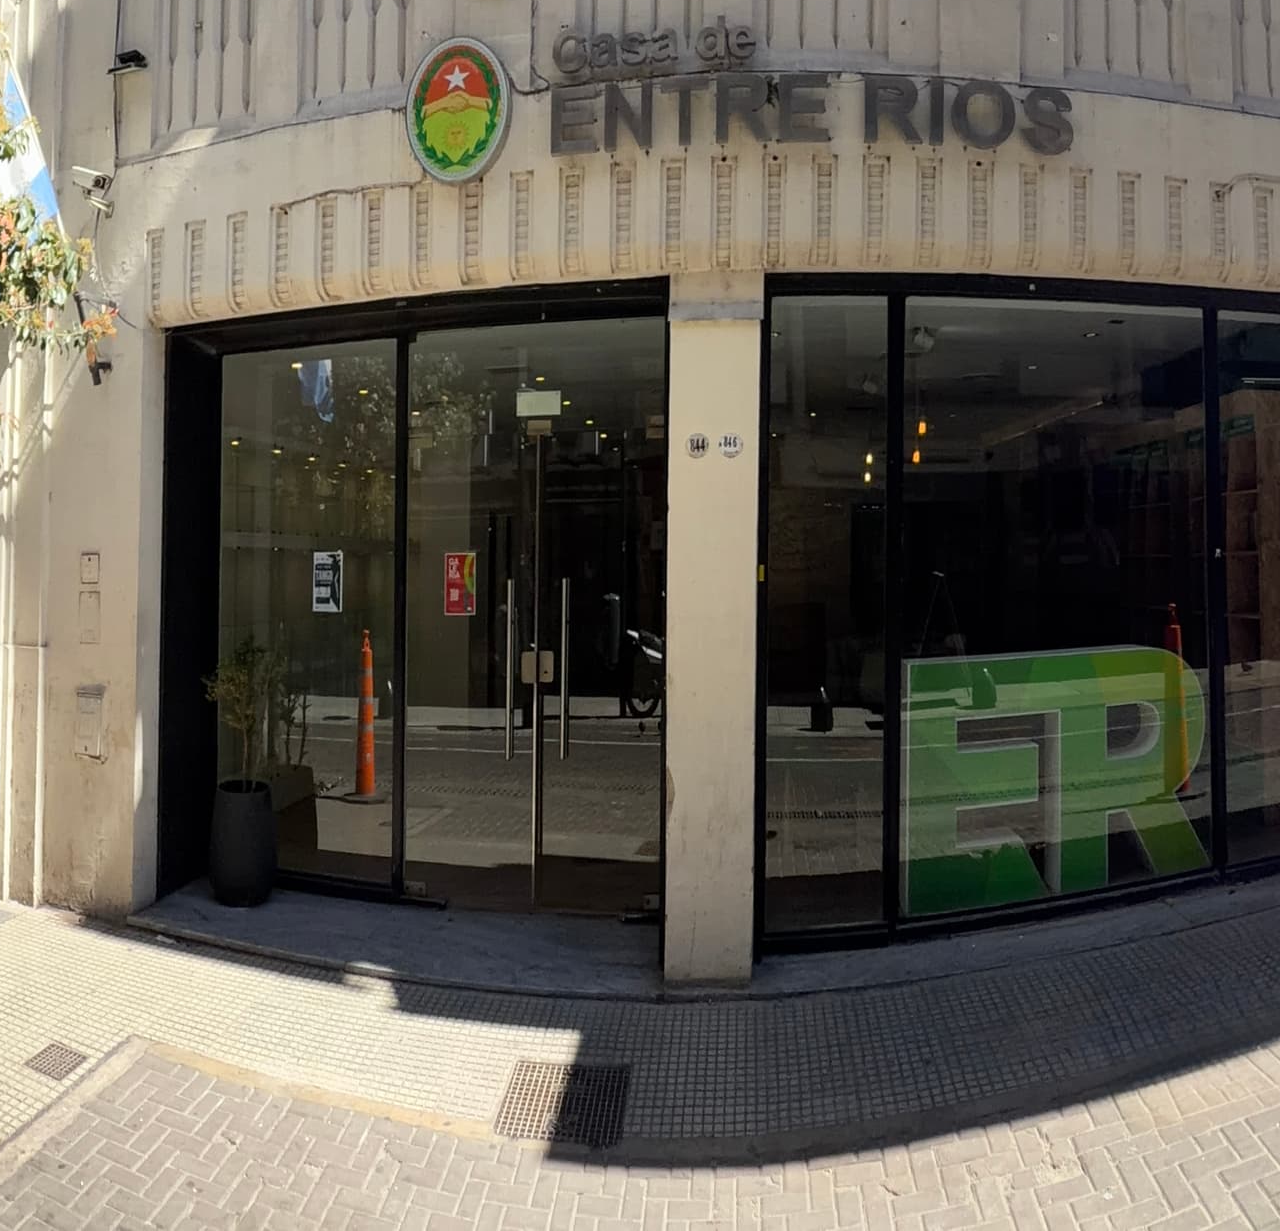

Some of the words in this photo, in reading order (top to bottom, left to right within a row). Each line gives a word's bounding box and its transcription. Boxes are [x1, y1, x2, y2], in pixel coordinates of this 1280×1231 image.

[696, 15, 756, 62] de
[551, 73, 831, 157] ENTRE
[864, 75, 1074, 156] RIOS
[690, 438, 705, 453] 844
[723, 436, 737, 448] 846
[900, 645, 1211, 918] ER
